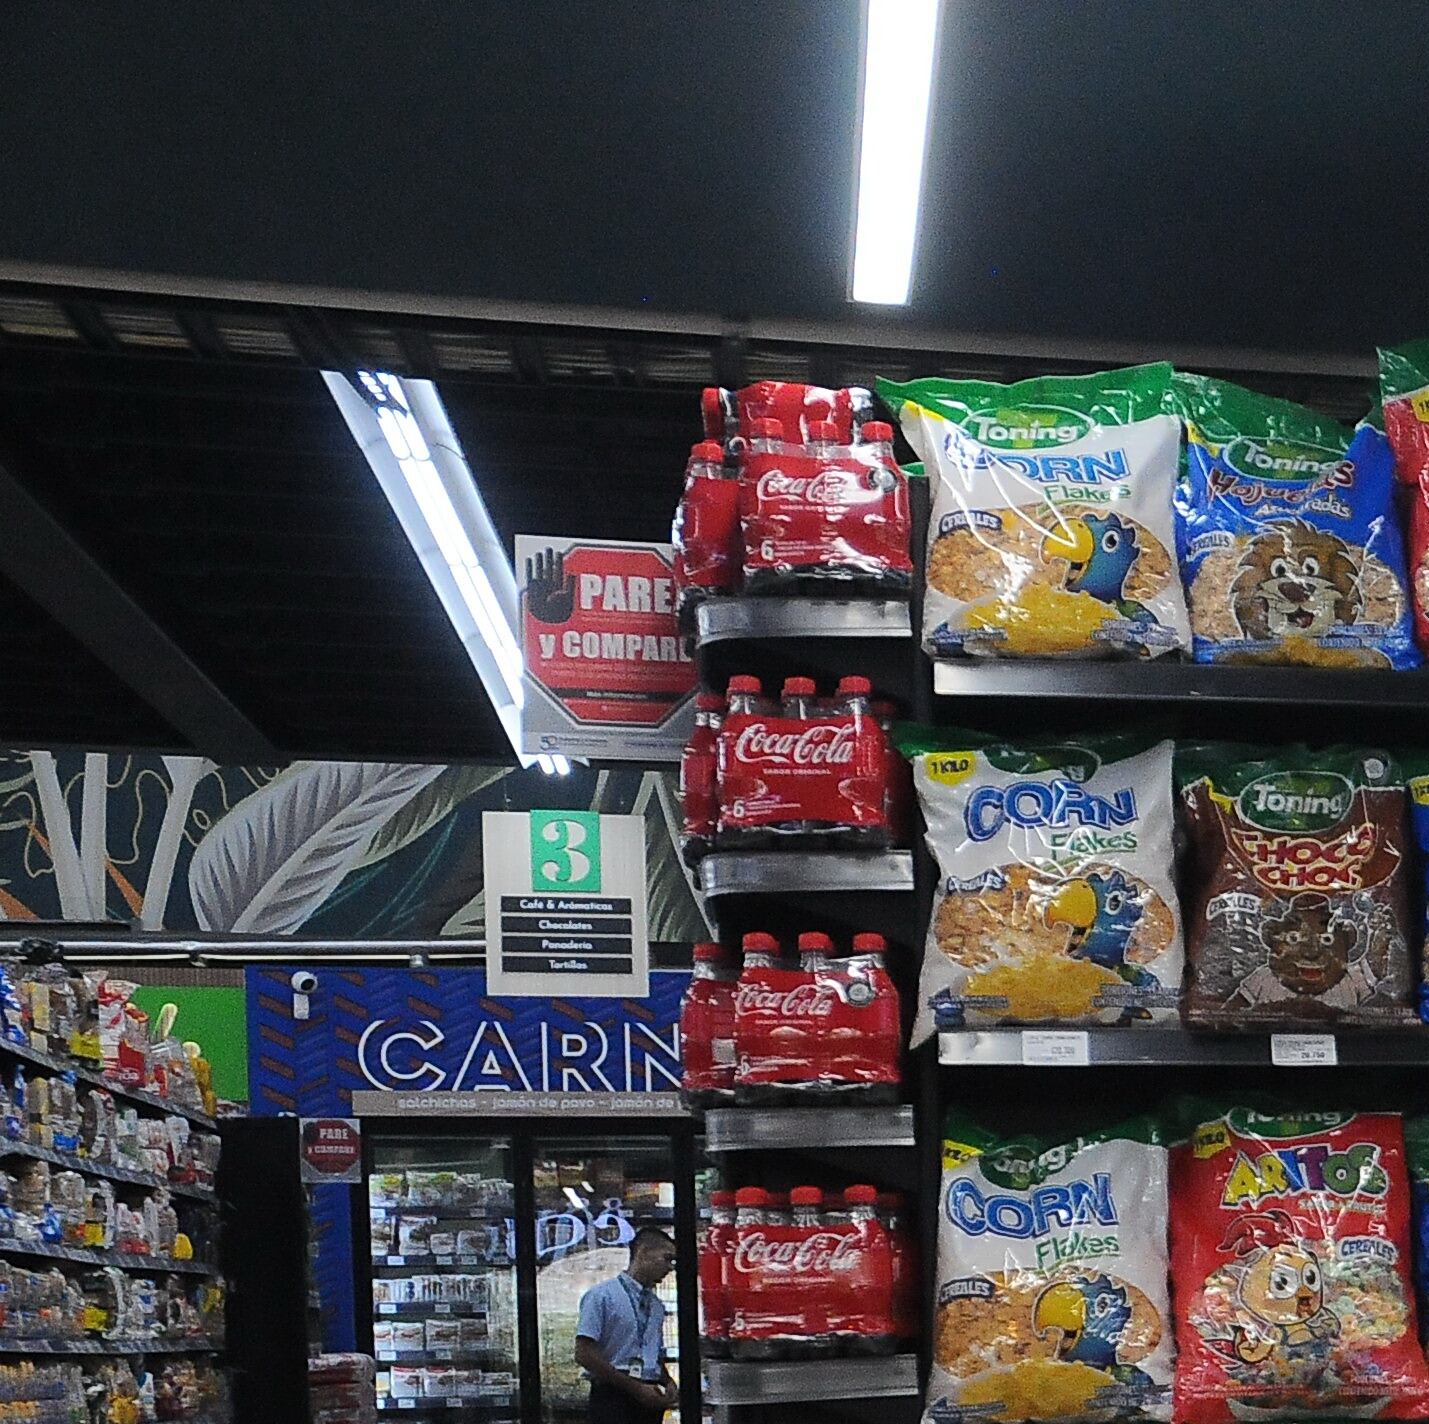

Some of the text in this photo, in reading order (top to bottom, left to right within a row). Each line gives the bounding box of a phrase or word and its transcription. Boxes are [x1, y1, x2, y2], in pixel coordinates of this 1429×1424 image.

[975, 416, 1078, 441] Toning
[580, 573, 673, 614] PARE
[539, 634, 556, 659] y
[964, 780, 1139, 842] CORN
[1253, 783, 1344, 818] Toning
[541, 819, 591, 883] 3
[538, 919, 593, 931] Chocolates
[548, 959, 589, 970] Tortillas
[1220, 1142, 1391, 1211] ARITOS
[947, 1172, 1120, 1238] CORN
[1340, 1238, 1396, 1258] CEREALES
